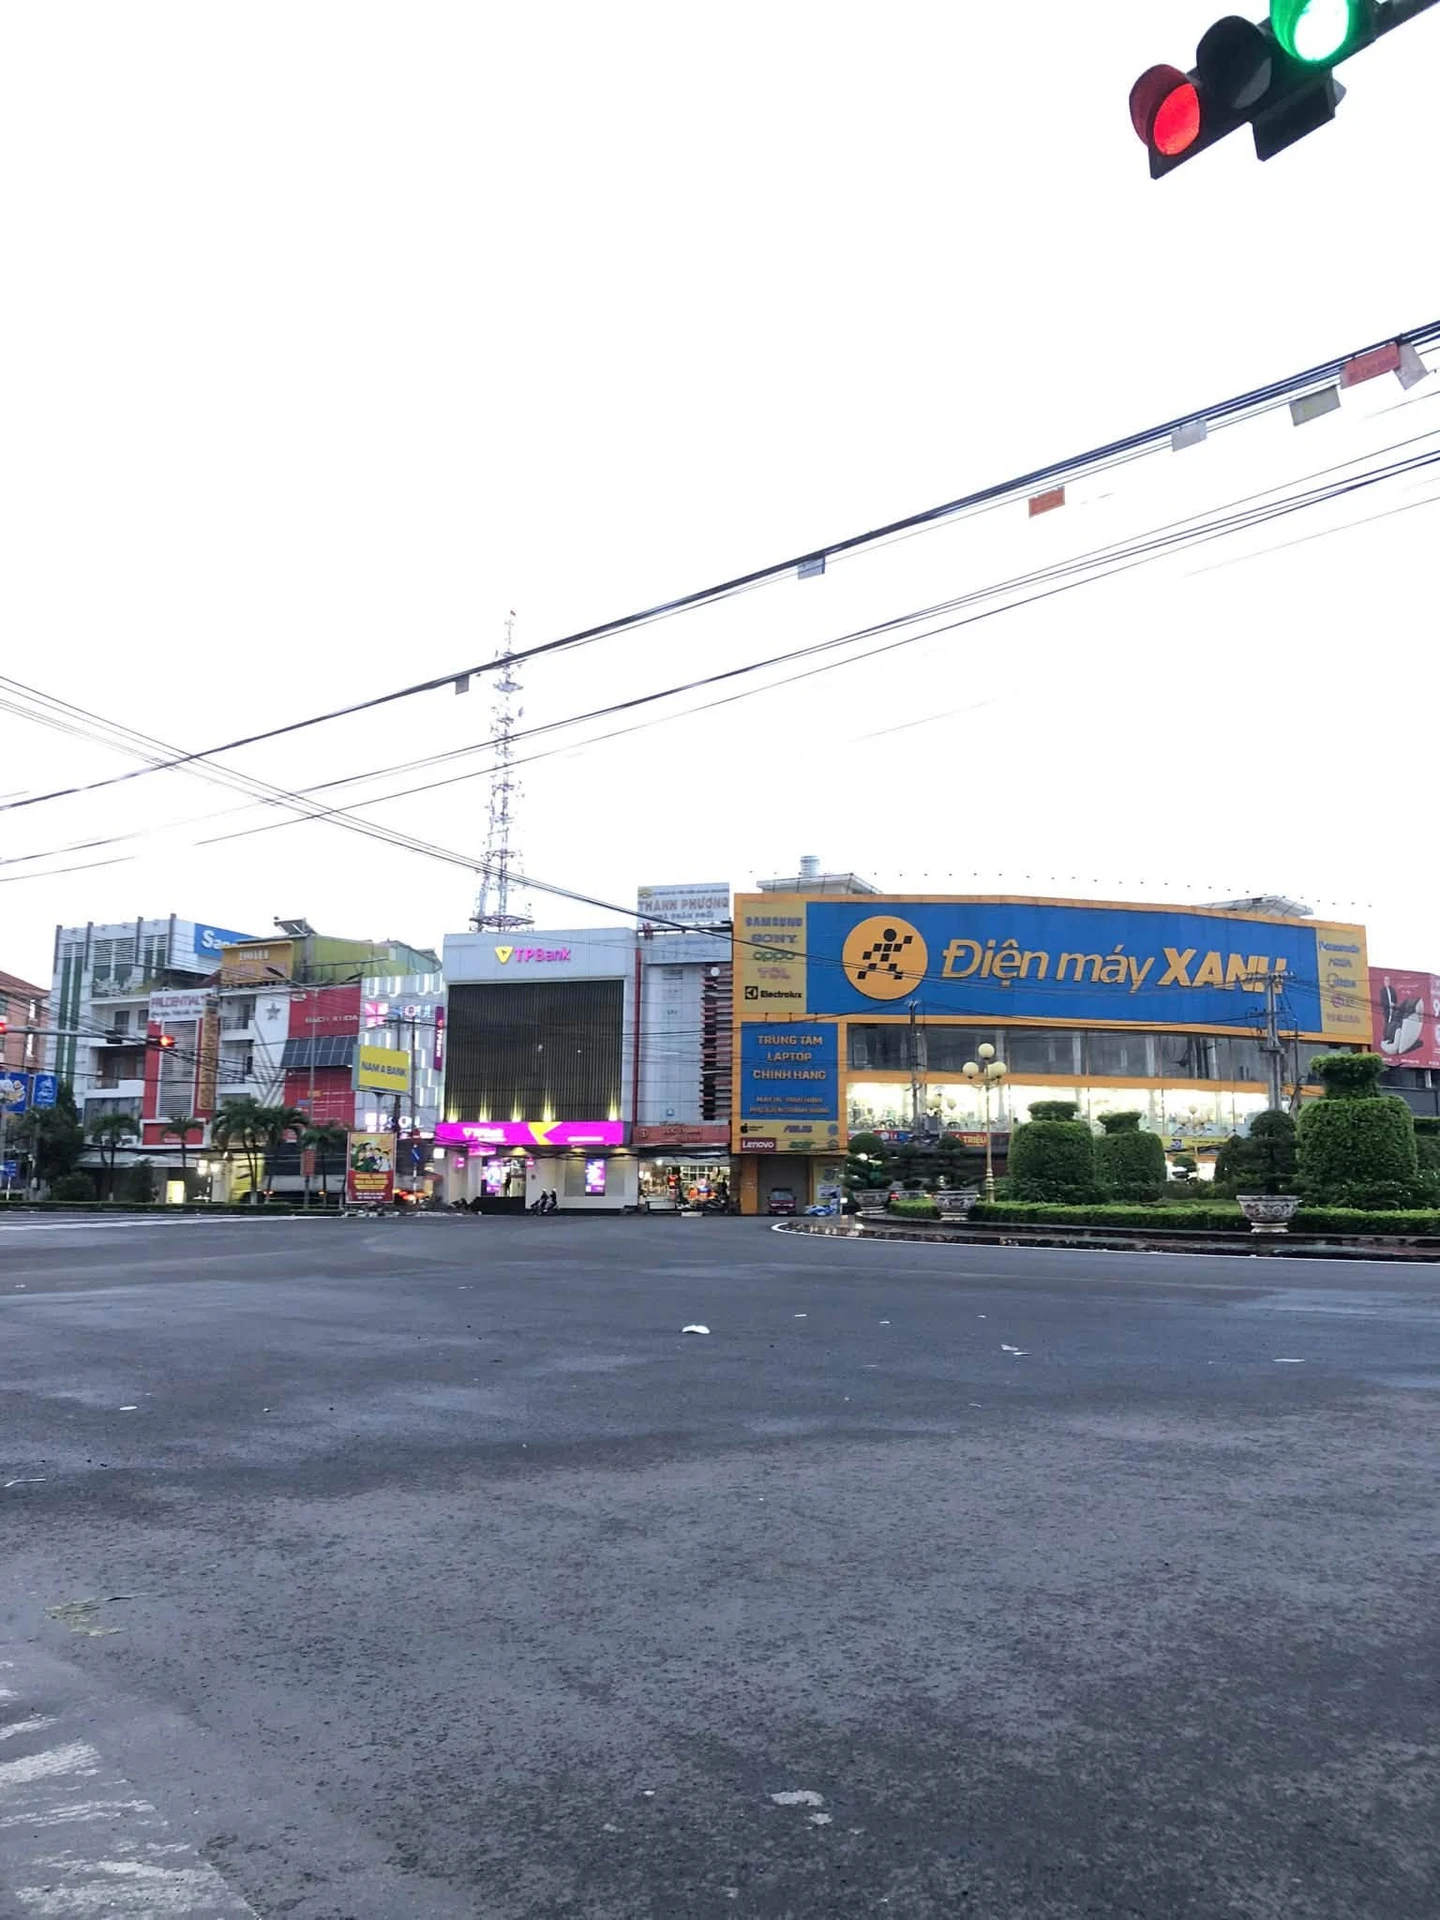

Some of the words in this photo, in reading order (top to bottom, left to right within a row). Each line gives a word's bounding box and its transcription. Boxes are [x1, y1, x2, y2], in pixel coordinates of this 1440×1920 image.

[745, 916, 803, 927] SAMSUNG
[751, 934, 797, 943] SONY
[514, 946, 571, 963] TPBank
[942, 939, 1049, 987] Điện
[1056, 945, 1154, 994] máy
[1157, 947, 1286, 993] XANH
[760, 990, 803, 998] Electrolux
[757, 1035, 797, 1045] TRUNG
[767, 1051, 812, 1062] LAPTOP
[742, 1140, 775, 1149] Lenovo
